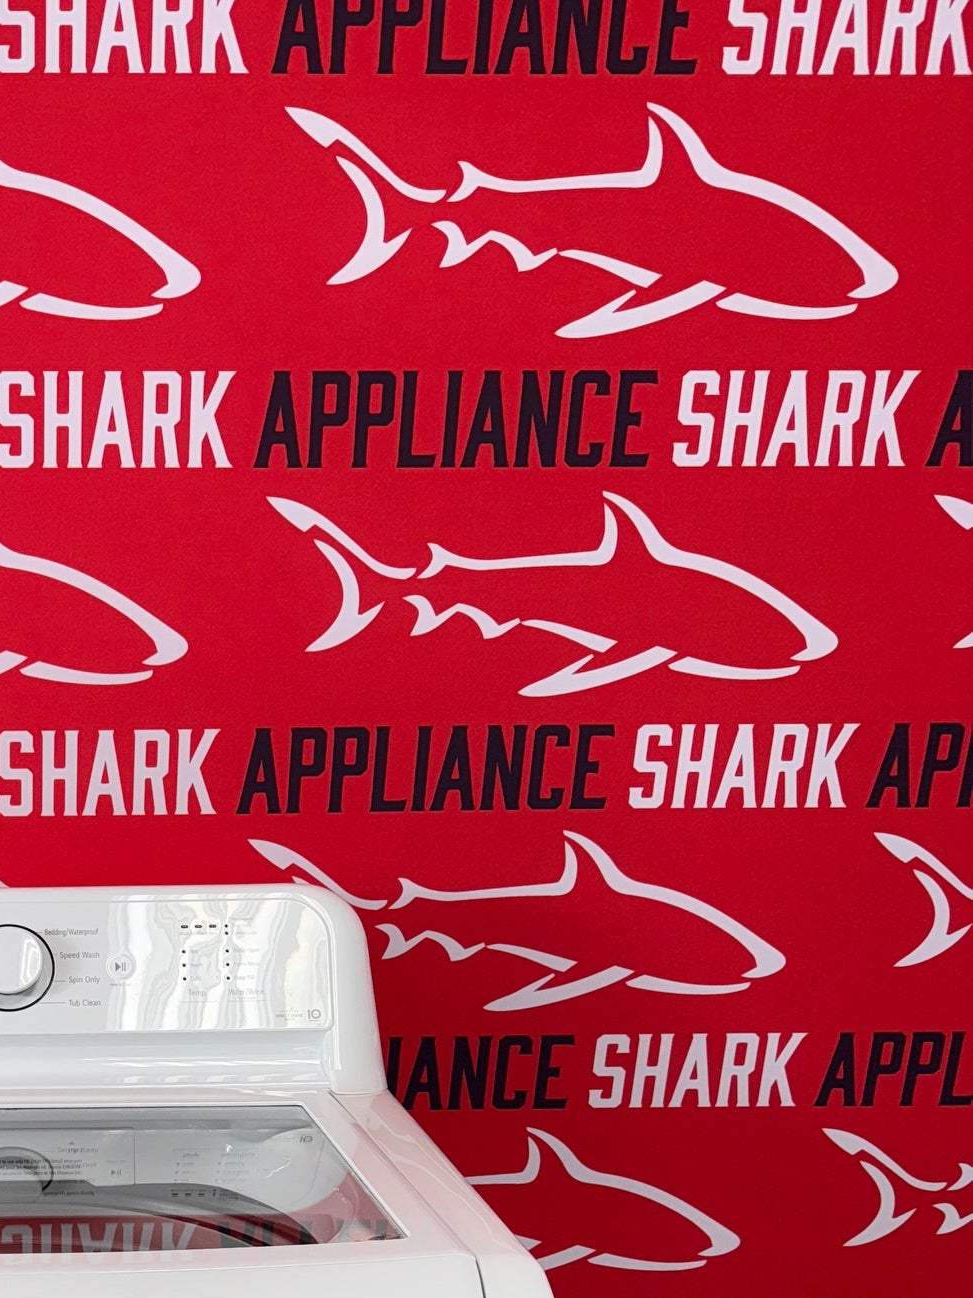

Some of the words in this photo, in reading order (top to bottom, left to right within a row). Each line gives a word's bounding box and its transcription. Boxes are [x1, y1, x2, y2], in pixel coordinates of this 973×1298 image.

[271, 0, 697, 75] APPLIANCE
[721, 0, 972, 76] SHARK
[254, 370, 658, 468] APPLIANCE
[672, 369, 921, 467] SHARK
[241, 725, 615, 814] APPLIANCE
[628, 723, 860, 809] SHARK
[44, 927, 99, 938] Bedding/Waterproof
[59, 951, 81, 961] Speed
[82, 951, 100, 959] Wash
[68, 976, 83, 985] Spin
[84, 976, 100, 985] Only
[68, 999, 81, 1007] Tub
[82, 999, 102, 1007] Clean
[588, 1032, 807, 1109] SHARK
[814, 1031, 973, 1107] APPL
